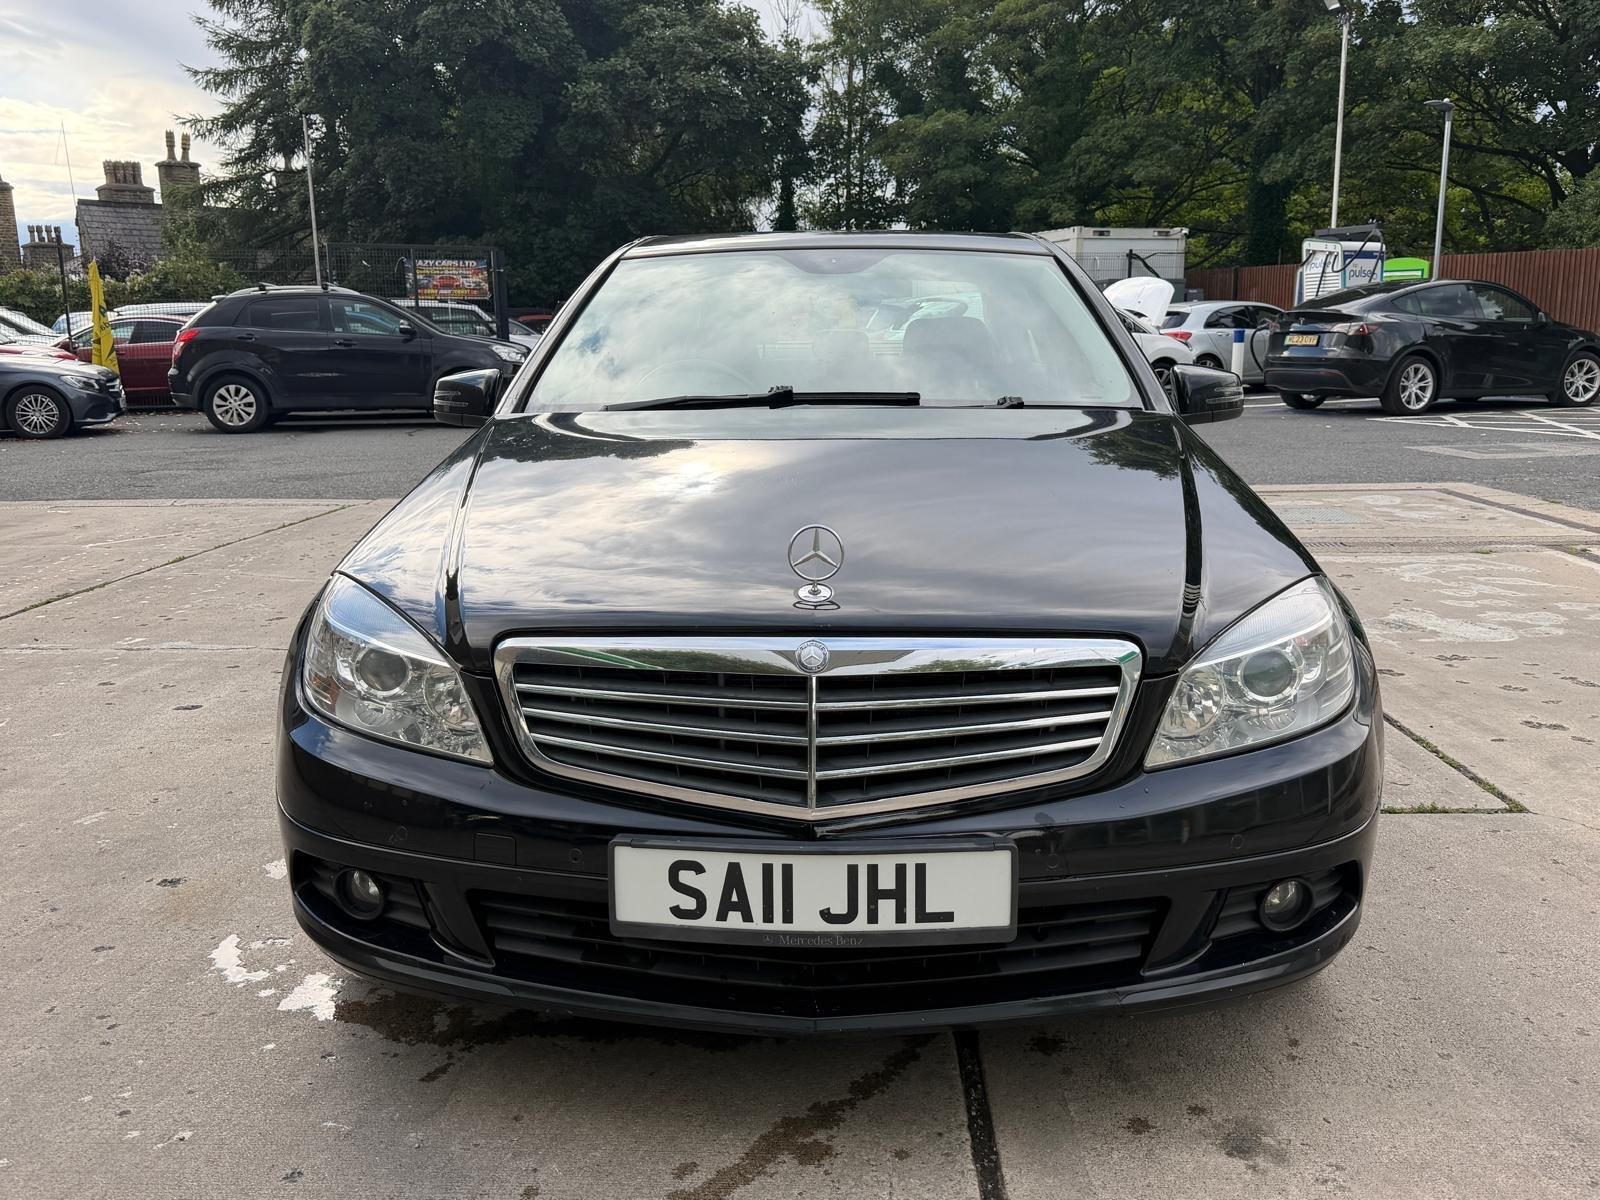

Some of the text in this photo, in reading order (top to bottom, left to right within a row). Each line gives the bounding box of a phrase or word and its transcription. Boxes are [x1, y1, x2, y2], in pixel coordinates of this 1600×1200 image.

[1348, 266, 1372, 280] pulse
[668, 859, 954, 924] SA11 JHL
[779, 935, 864, 945] Mercedes Benz
